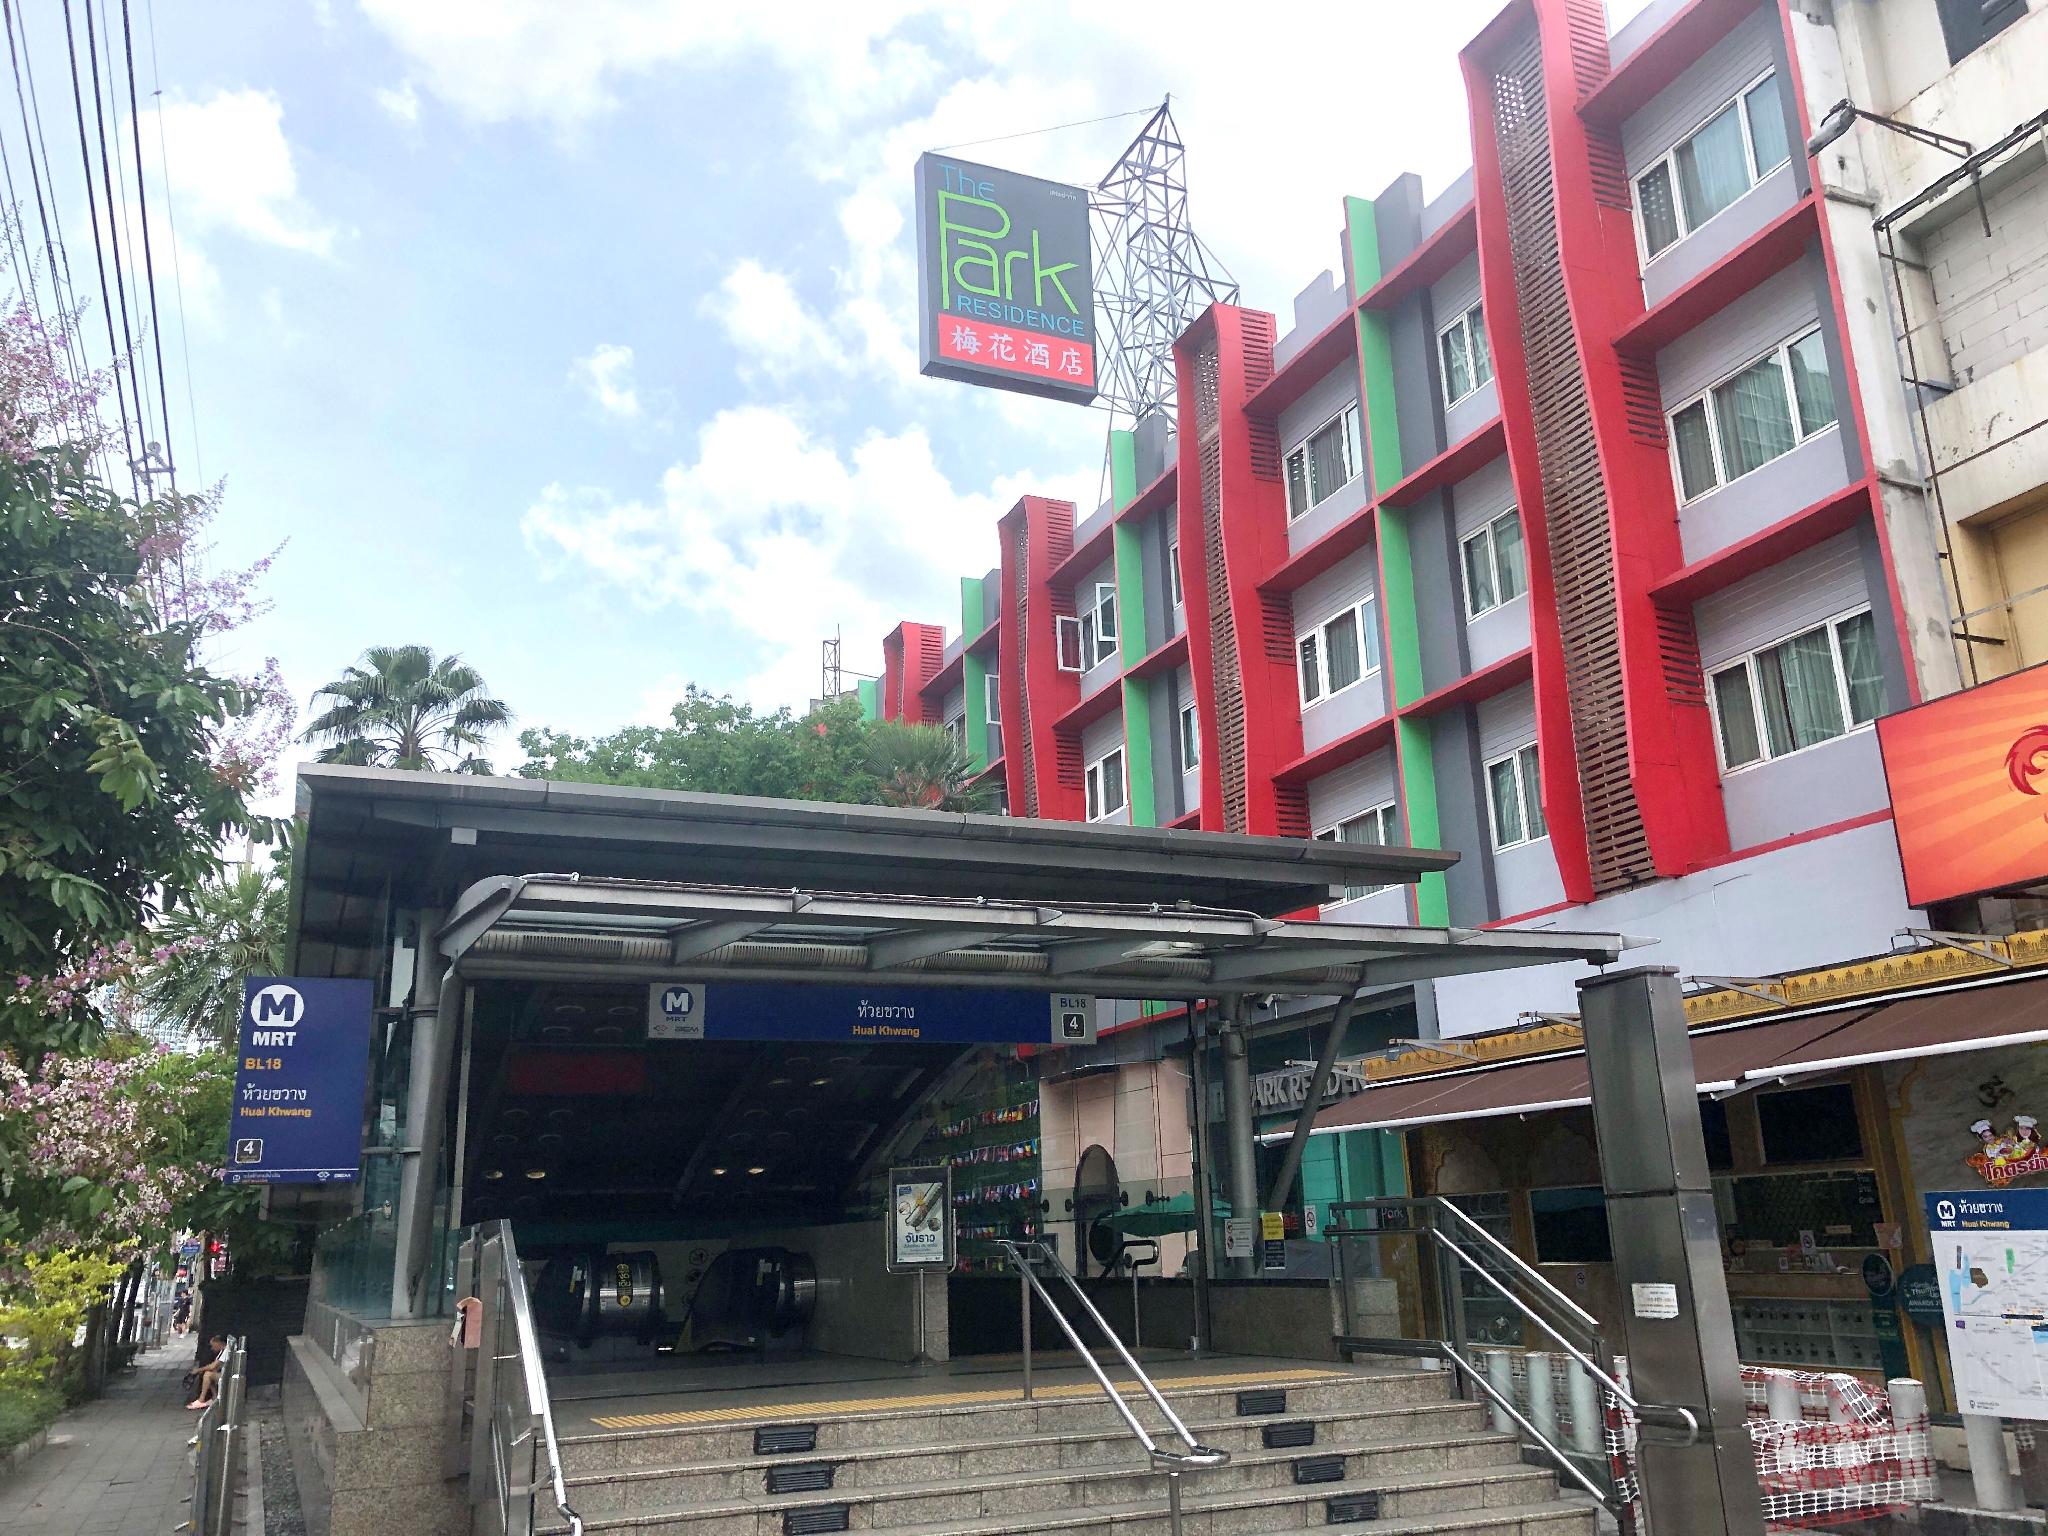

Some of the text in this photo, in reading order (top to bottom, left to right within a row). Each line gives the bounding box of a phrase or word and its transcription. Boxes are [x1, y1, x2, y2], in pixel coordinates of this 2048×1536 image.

[937, 163, 995, 201] The
[937, 189, 1080, 316] Park
[957, 295, 1086, 337] RESIDENCE
[951, 325, 1084, 377] 梅花酒店
[857, 999, 915, 1019] ห้วยขวาง
[1060, 997, 1086, 1008] BL18
[1069, 1015, 1079, 1030] 4
[252, 1031, 297, 1047] MRT
[852, 1025, 920, 1038] Huai Khwang
[244, 1057, 282, 1070] BL18
[242, 1082, 307, 1101] ห้วยขวาง
[240, 1106, 312, 1118] Huai Khwang
[243, 1140, 255, 1155] 4
[1959, 1198, 2003, 1214] ห้วยขวาง
[1941, 1220, 1956, 1228] MRT
[1961, 1220, 2010, 1229] Huai Khwang
